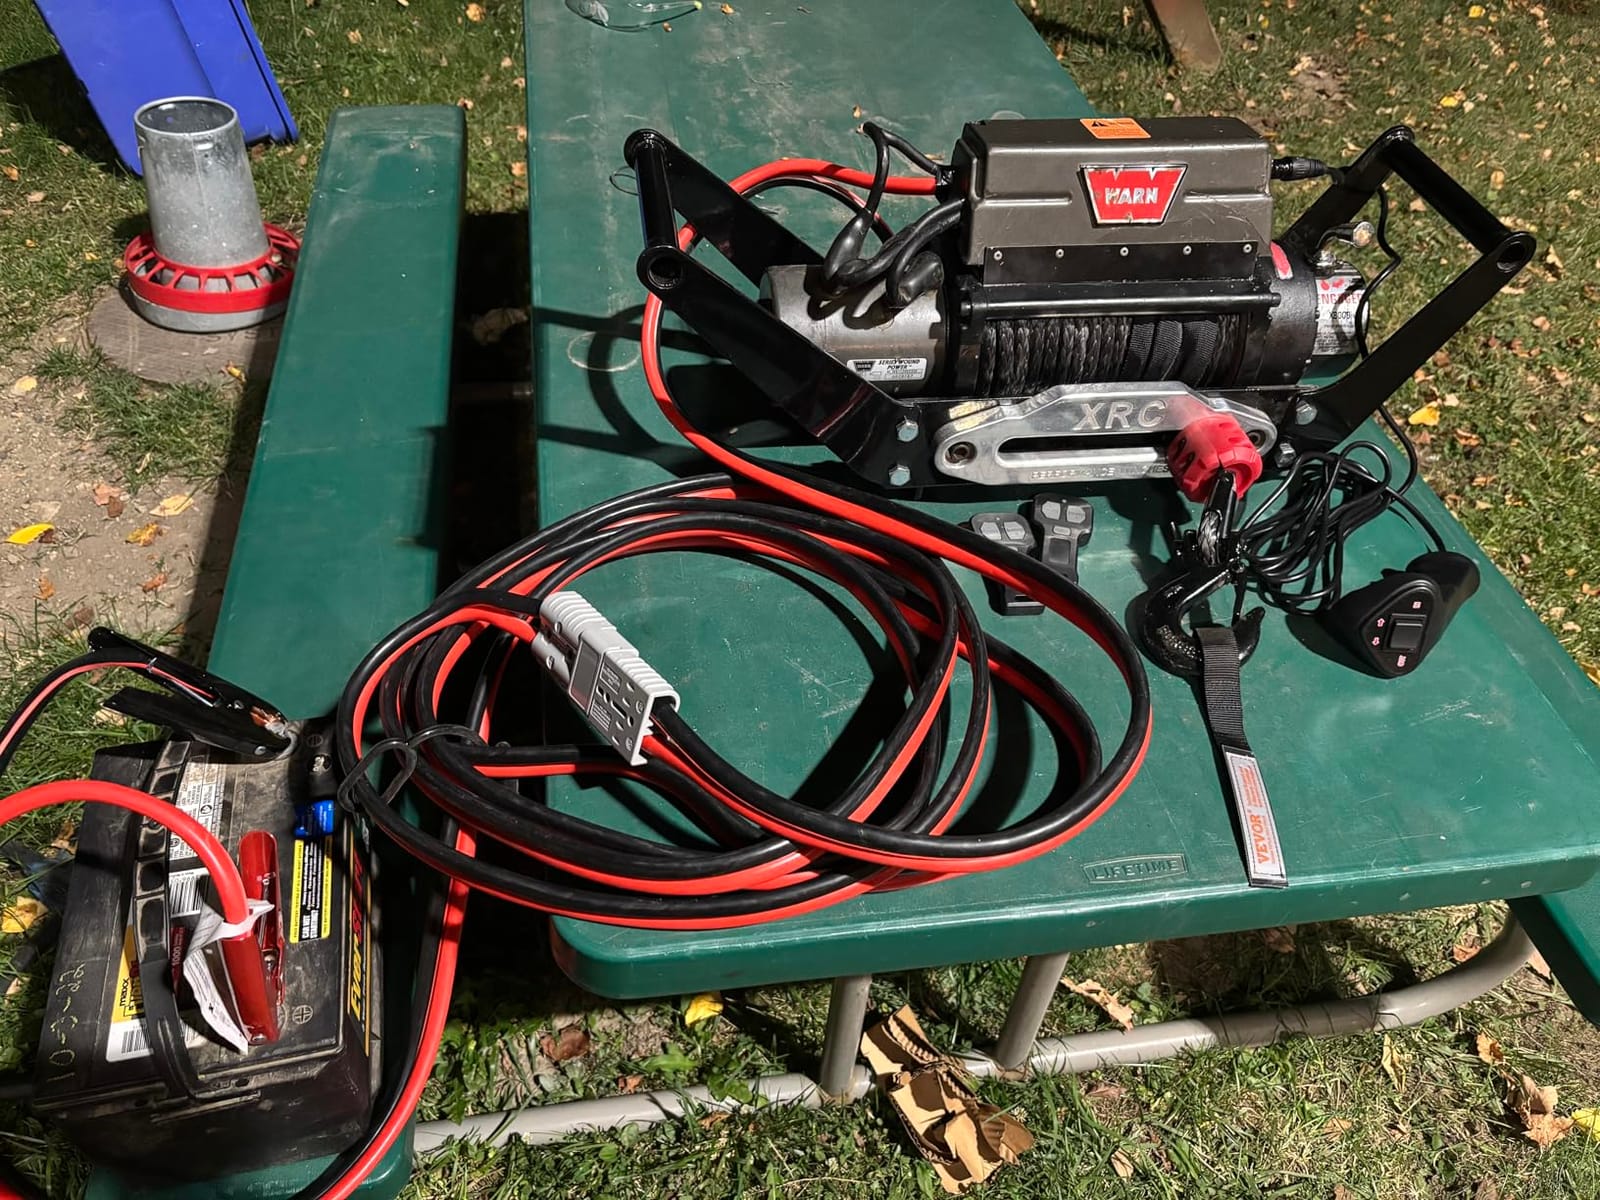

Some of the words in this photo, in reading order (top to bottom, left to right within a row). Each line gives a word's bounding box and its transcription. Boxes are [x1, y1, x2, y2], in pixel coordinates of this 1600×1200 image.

[1104, 187, 1159, 205] WARN
[1073, 399, 1168, 430] XRC
[1249, 813, 1267, 864] VEVOR
[1091, 860, 1182, 880] LIFETIME
[172, 946, 182, 967] 1000
[119, 976, 129, 1007] maxx
